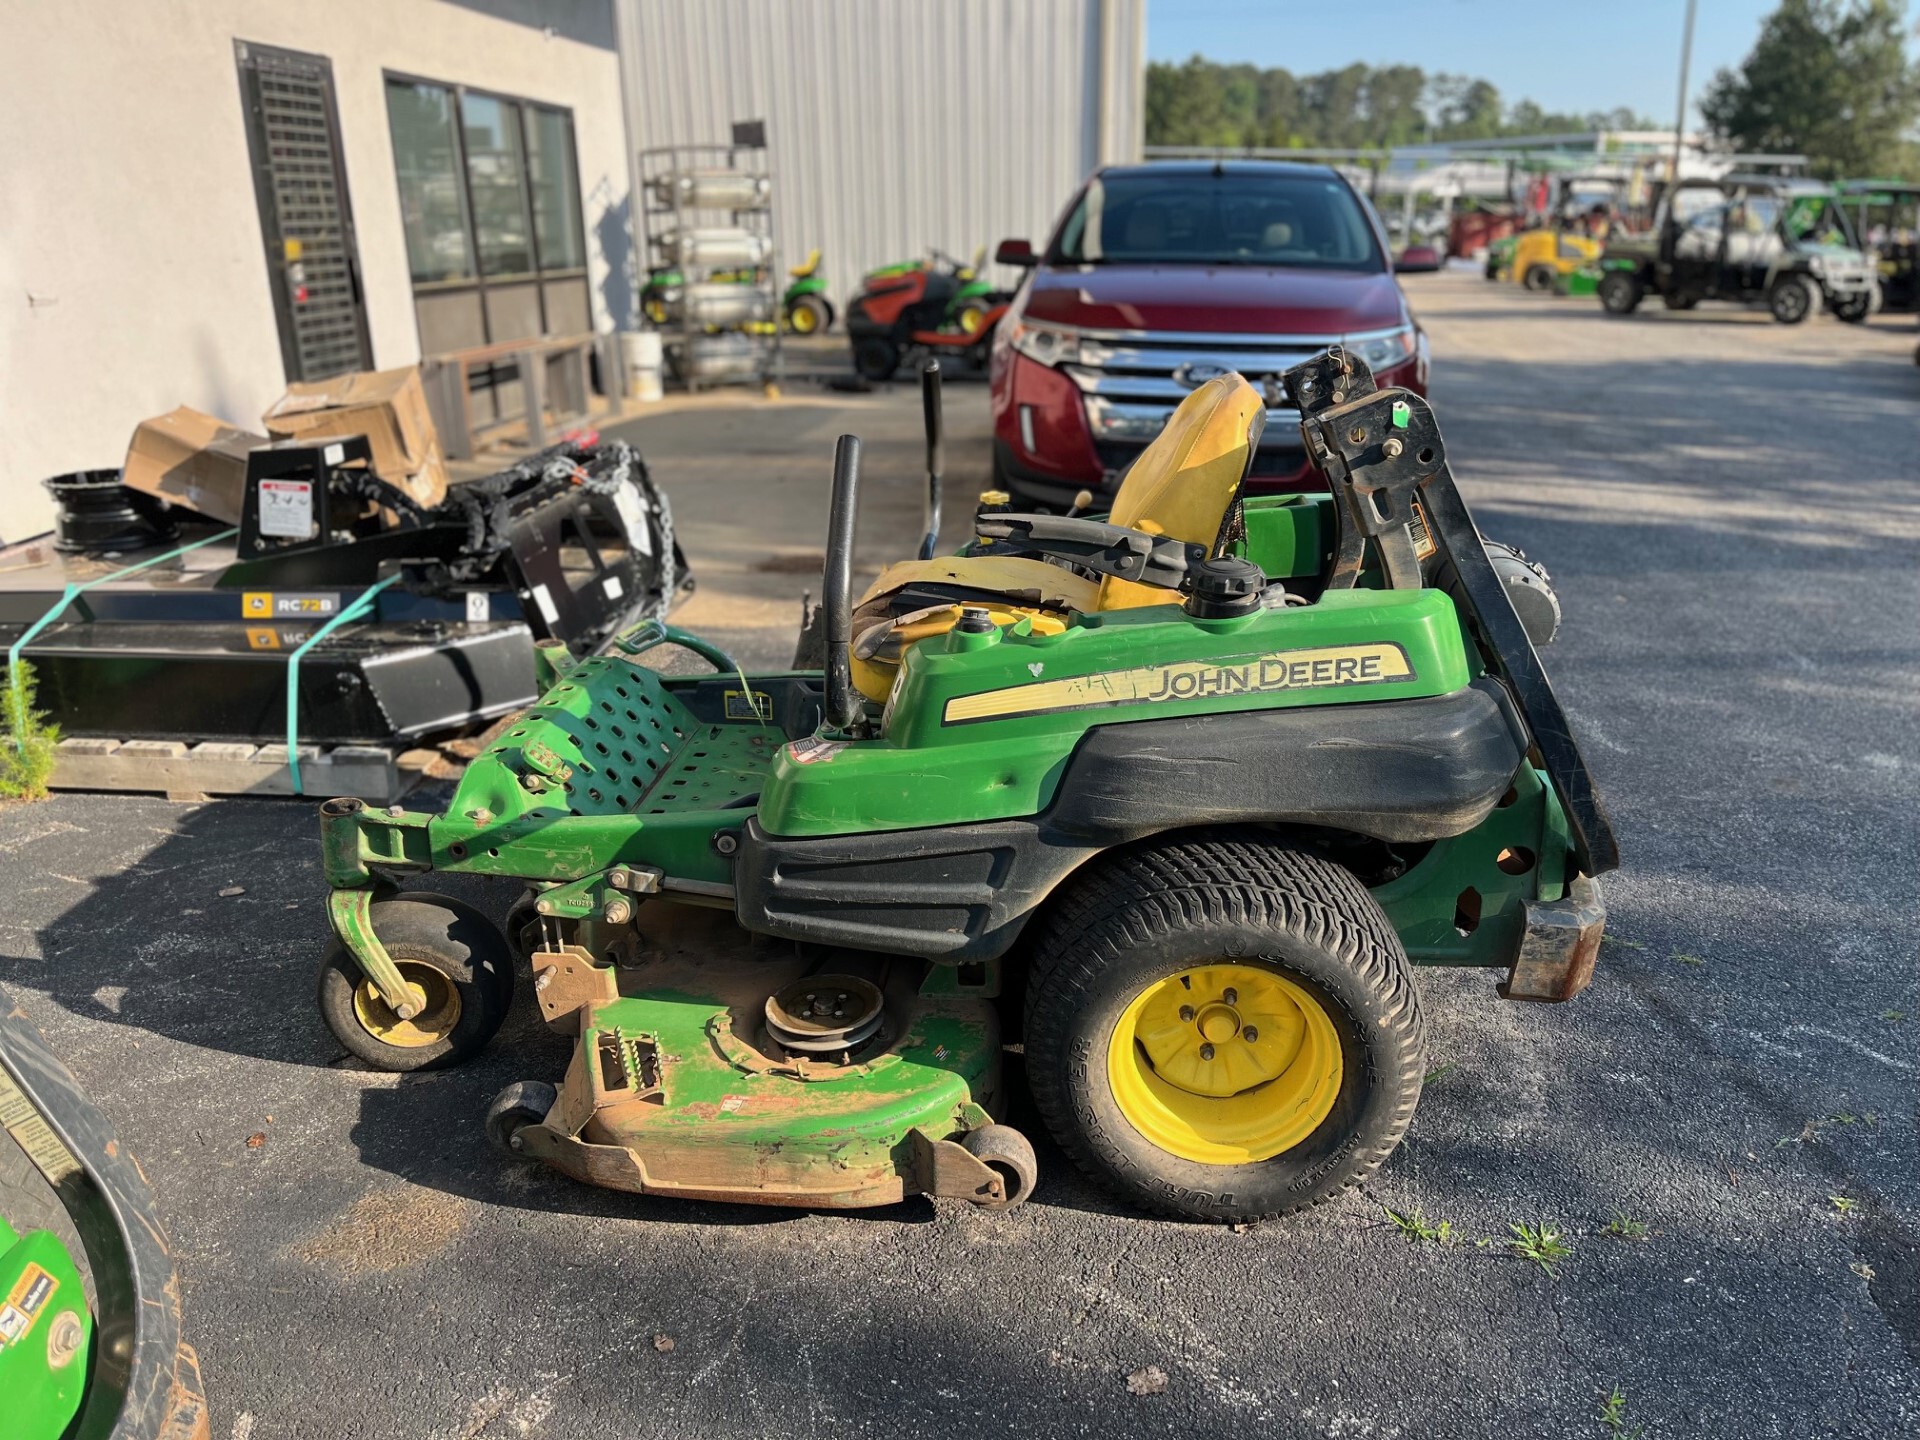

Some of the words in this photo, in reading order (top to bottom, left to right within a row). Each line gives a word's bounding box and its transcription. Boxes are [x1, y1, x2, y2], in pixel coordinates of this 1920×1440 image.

[278, 599, 332, 611] RC72B
[1149, 666, 1250, 699] JOHN
[1259, 655, 1382, 688] DEERE
[1067, 1034, 1138, 1176] MASTER
[1136, 1176, 1239, 1208] TURF
